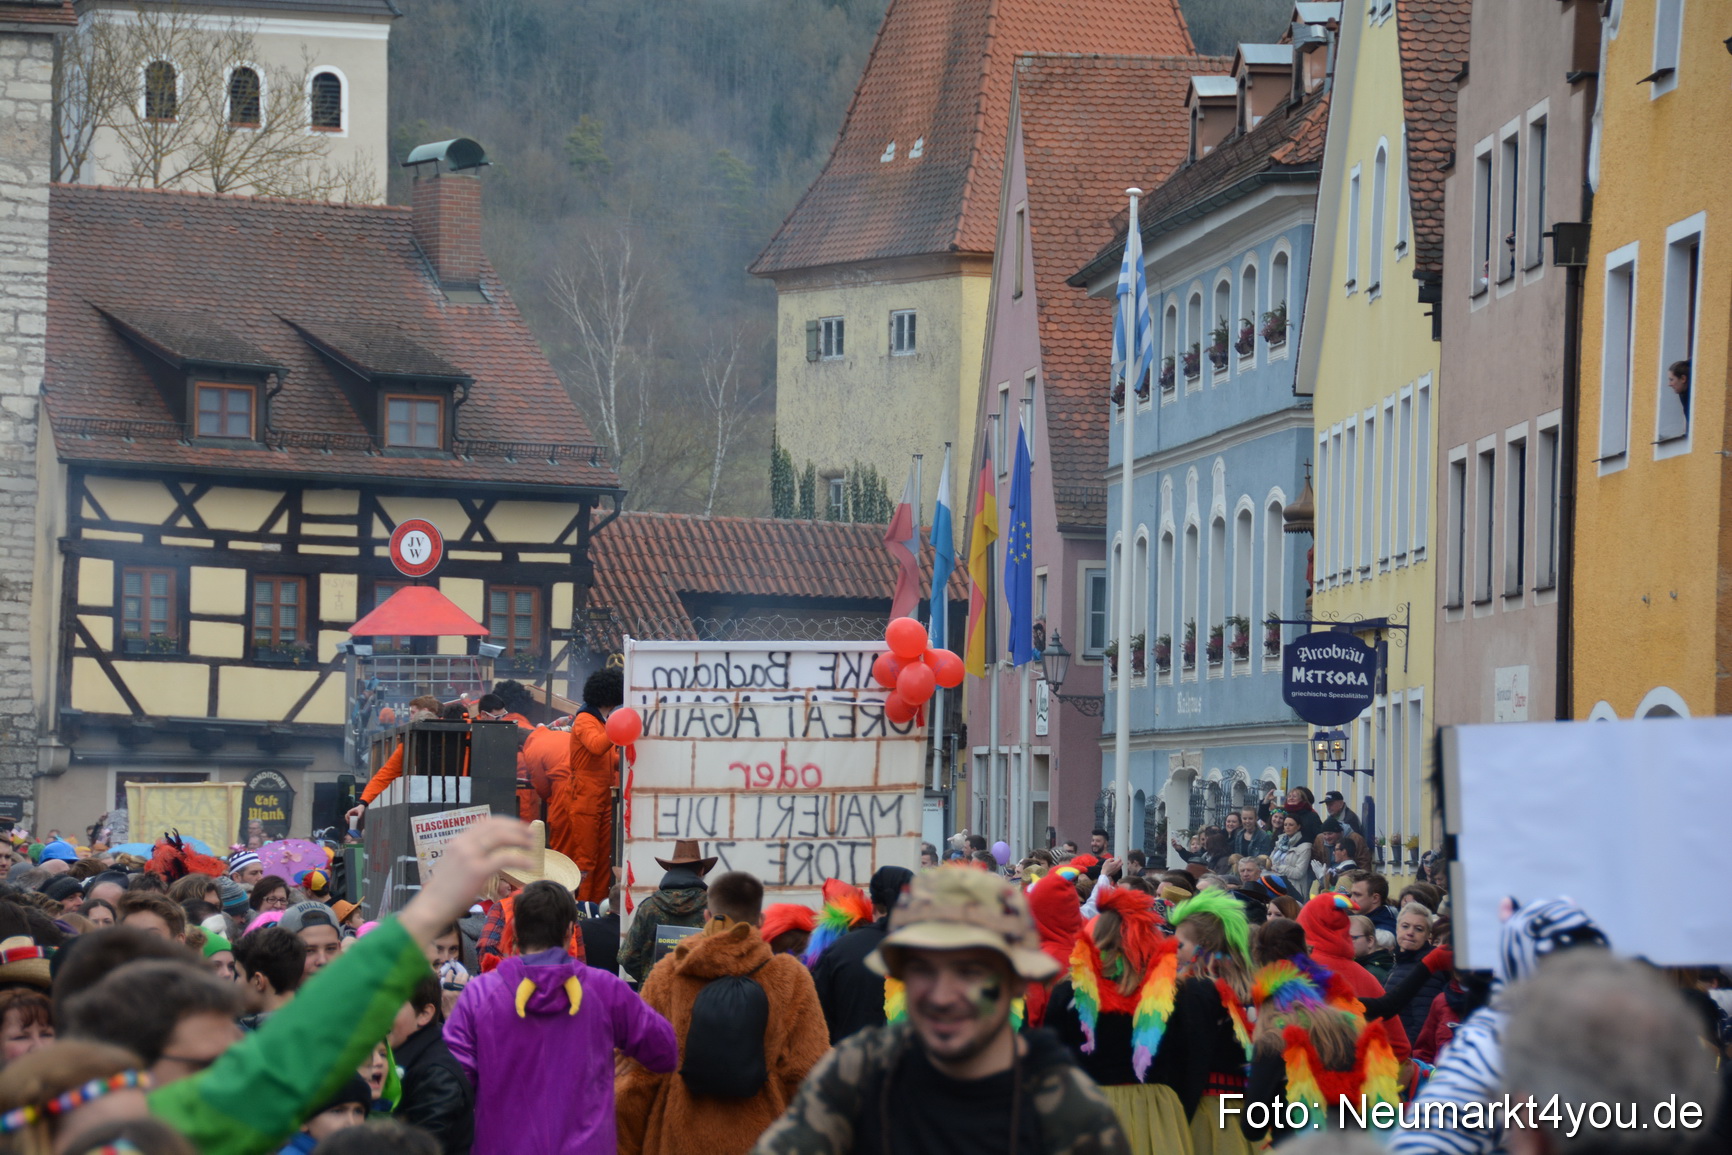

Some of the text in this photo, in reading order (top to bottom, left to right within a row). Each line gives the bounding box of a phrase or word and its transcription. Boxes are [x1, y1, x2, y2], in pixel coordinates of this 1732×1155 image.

[407, 536, 425, 548] JV
[409, 548, 422, 559] W
[1296, 643, 1365, 665] Arcobräu
[1291, 666, 1369, 686] METEORA
[1291, 690, 1369, 700] griechische Spezialitäten
[248, 771, 287, 790] KONDITOREI
[254, 794, 280, 807] Cafe
[415, 812, 489, 833] FLASCHENPARTY
[438, 830, 454, 838] GREAT
[297, 902, 326, 913] BULLS
